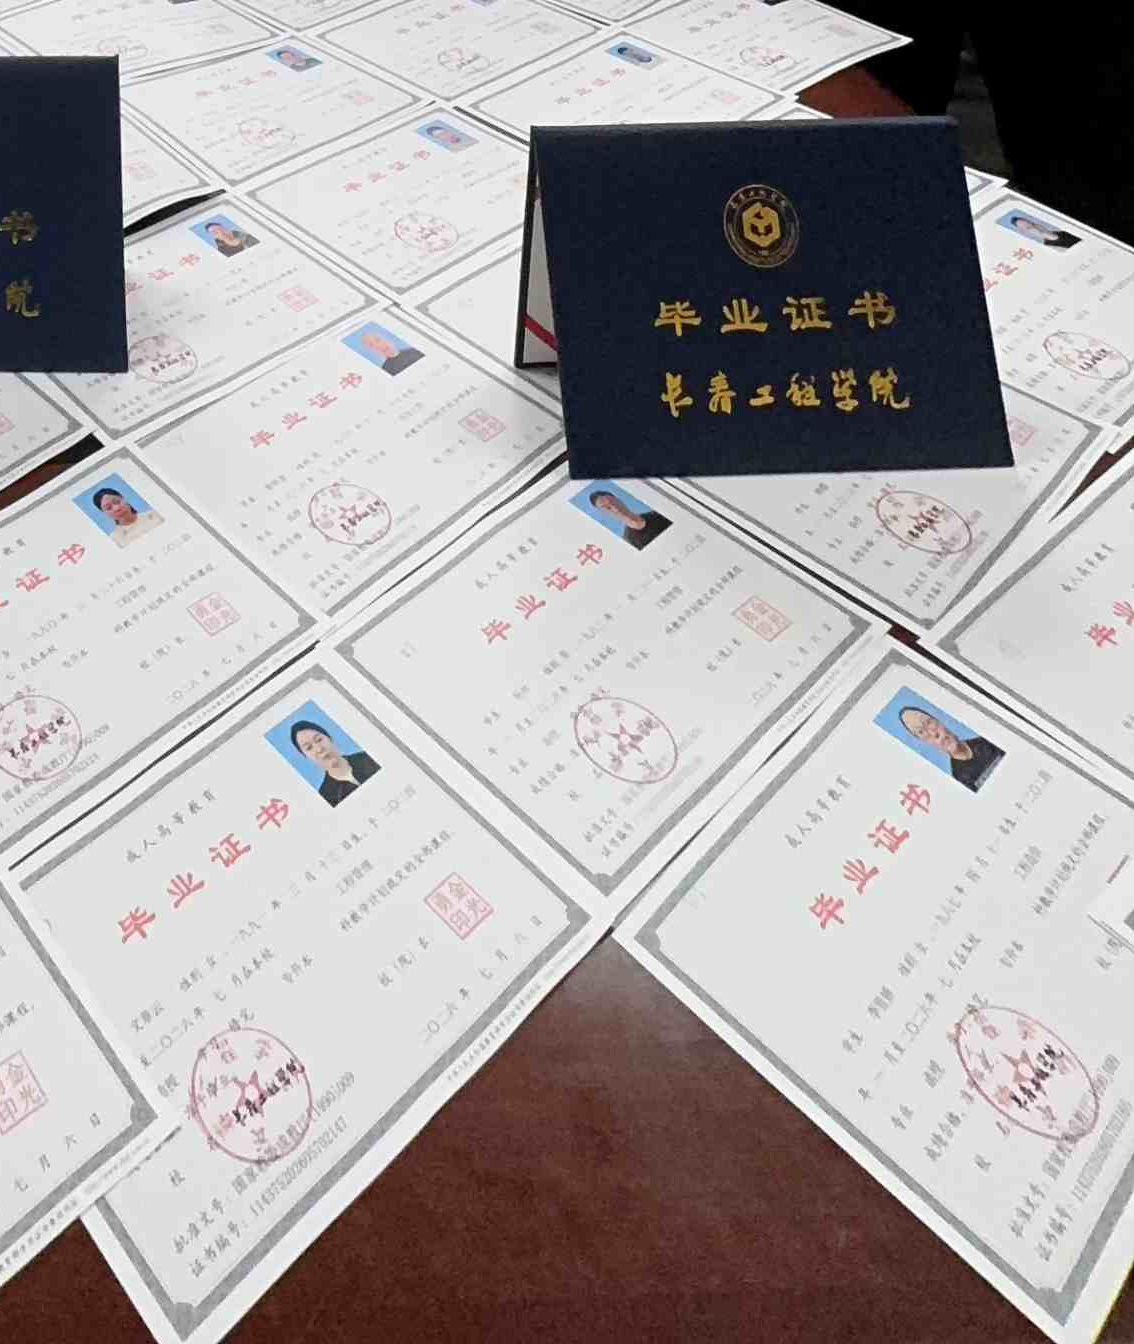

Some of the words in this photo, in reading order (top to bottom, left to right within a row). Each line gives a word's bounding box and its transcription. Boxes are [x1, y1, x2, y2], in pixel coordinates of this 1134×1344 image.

[653, 290, 898, 336] 毕业证书
[249, 371, 363, 449] 毕业证书
[660, 366, 914, 418] 长春工程学院
[482, 544, 603, 644] 毕业证书
[127, 788, 216, 863] 成人高等教育
[809, 784, 930, 930] 毕业证书
[117, 798, 289, 944] 毕业证书
